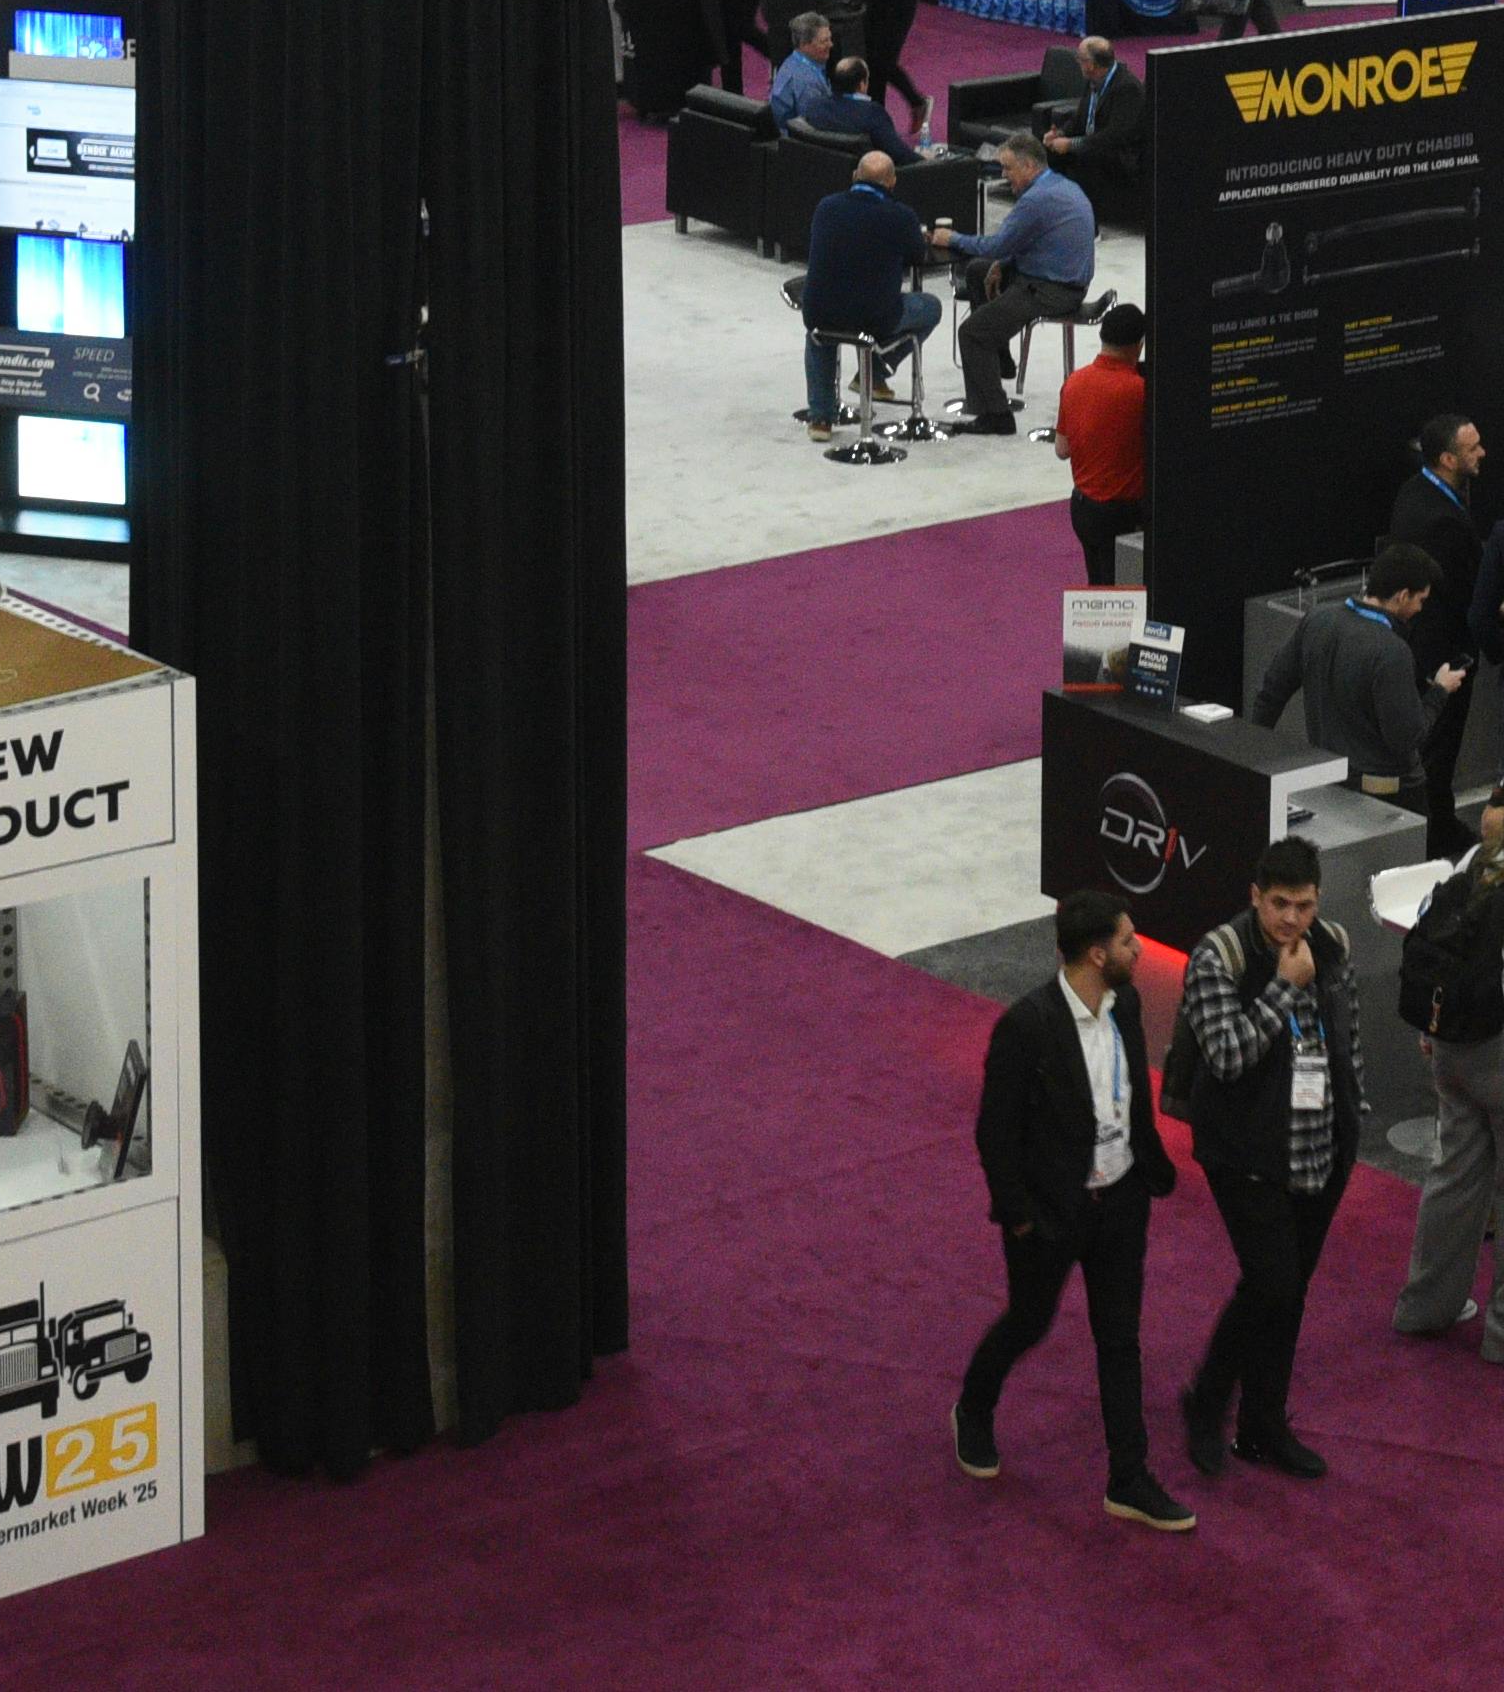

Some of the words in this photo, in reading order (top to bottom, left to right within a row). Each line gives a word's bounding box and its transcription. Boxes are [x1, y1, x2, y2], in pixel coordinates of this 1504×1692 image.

[1256, 47, 1448, 121] MONROE
[1219, 176, 1338, 202] APPLICATION-ENGINEERED
[1339, 169, 1391, 186] DURABILITY
[1393, 164, 1411, 178] FOR
[1413, 161, 1429, 173] THE
[1431, 157, 1456, 171] LONG
[1457, 154, 1480, 165] HAUL
[1226, 156, 1324, 182] INTRODUCING
[1326, 147, 1372, 168] HEAVY
[1376, 141, 1412, 160] DUTY
[1416, 132, 1474, 154] CHASSIS
[74, 346, 115, 363] SPEED
[1139, 649, 1168, 664] PROUD
[80, 1492, 128, 1528] Week
[132, 1478, 158, 1506] '25
